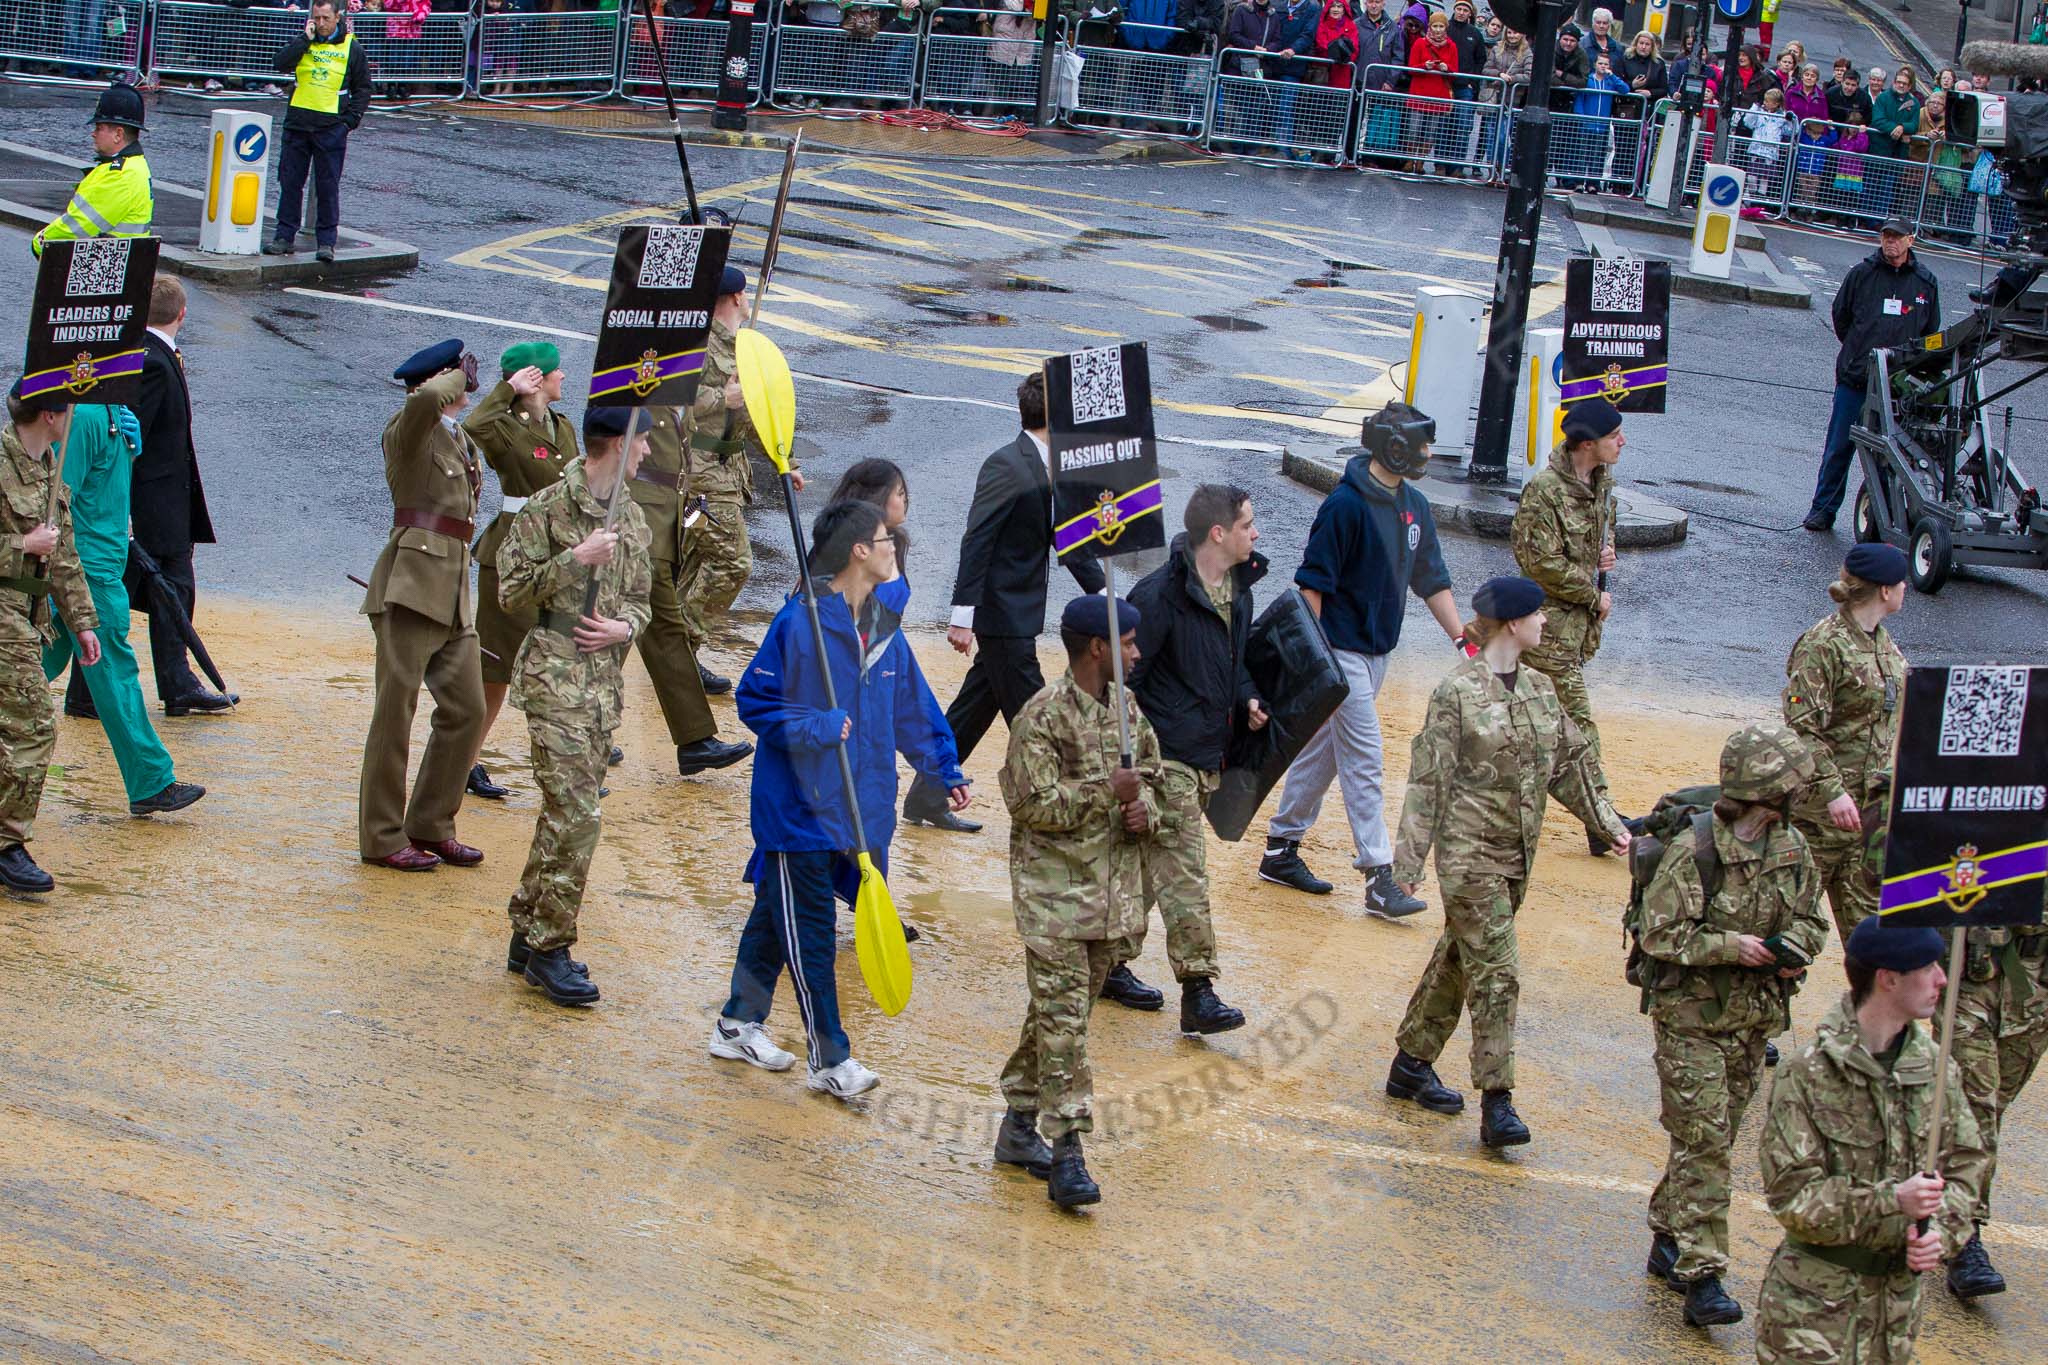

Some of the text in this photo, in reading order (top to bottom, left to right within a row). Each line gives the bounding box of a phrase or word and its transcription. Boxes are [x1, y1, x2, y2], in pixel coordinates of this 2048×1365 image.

[48, 304, 133, 324] LEADERS OF
[607, 309, 708, 328] SOCIAL EVENTS
[51, 325, 124, 343] INDUSTRY
[1569, 322, 1662, 340] ADVENTUROUS
[1585, 340, 1645, 358] TRAINING
[1060, 437, 1142, 471] PASSING OUT
[1901, 785, 2047, 812] NEW RECRUITS
